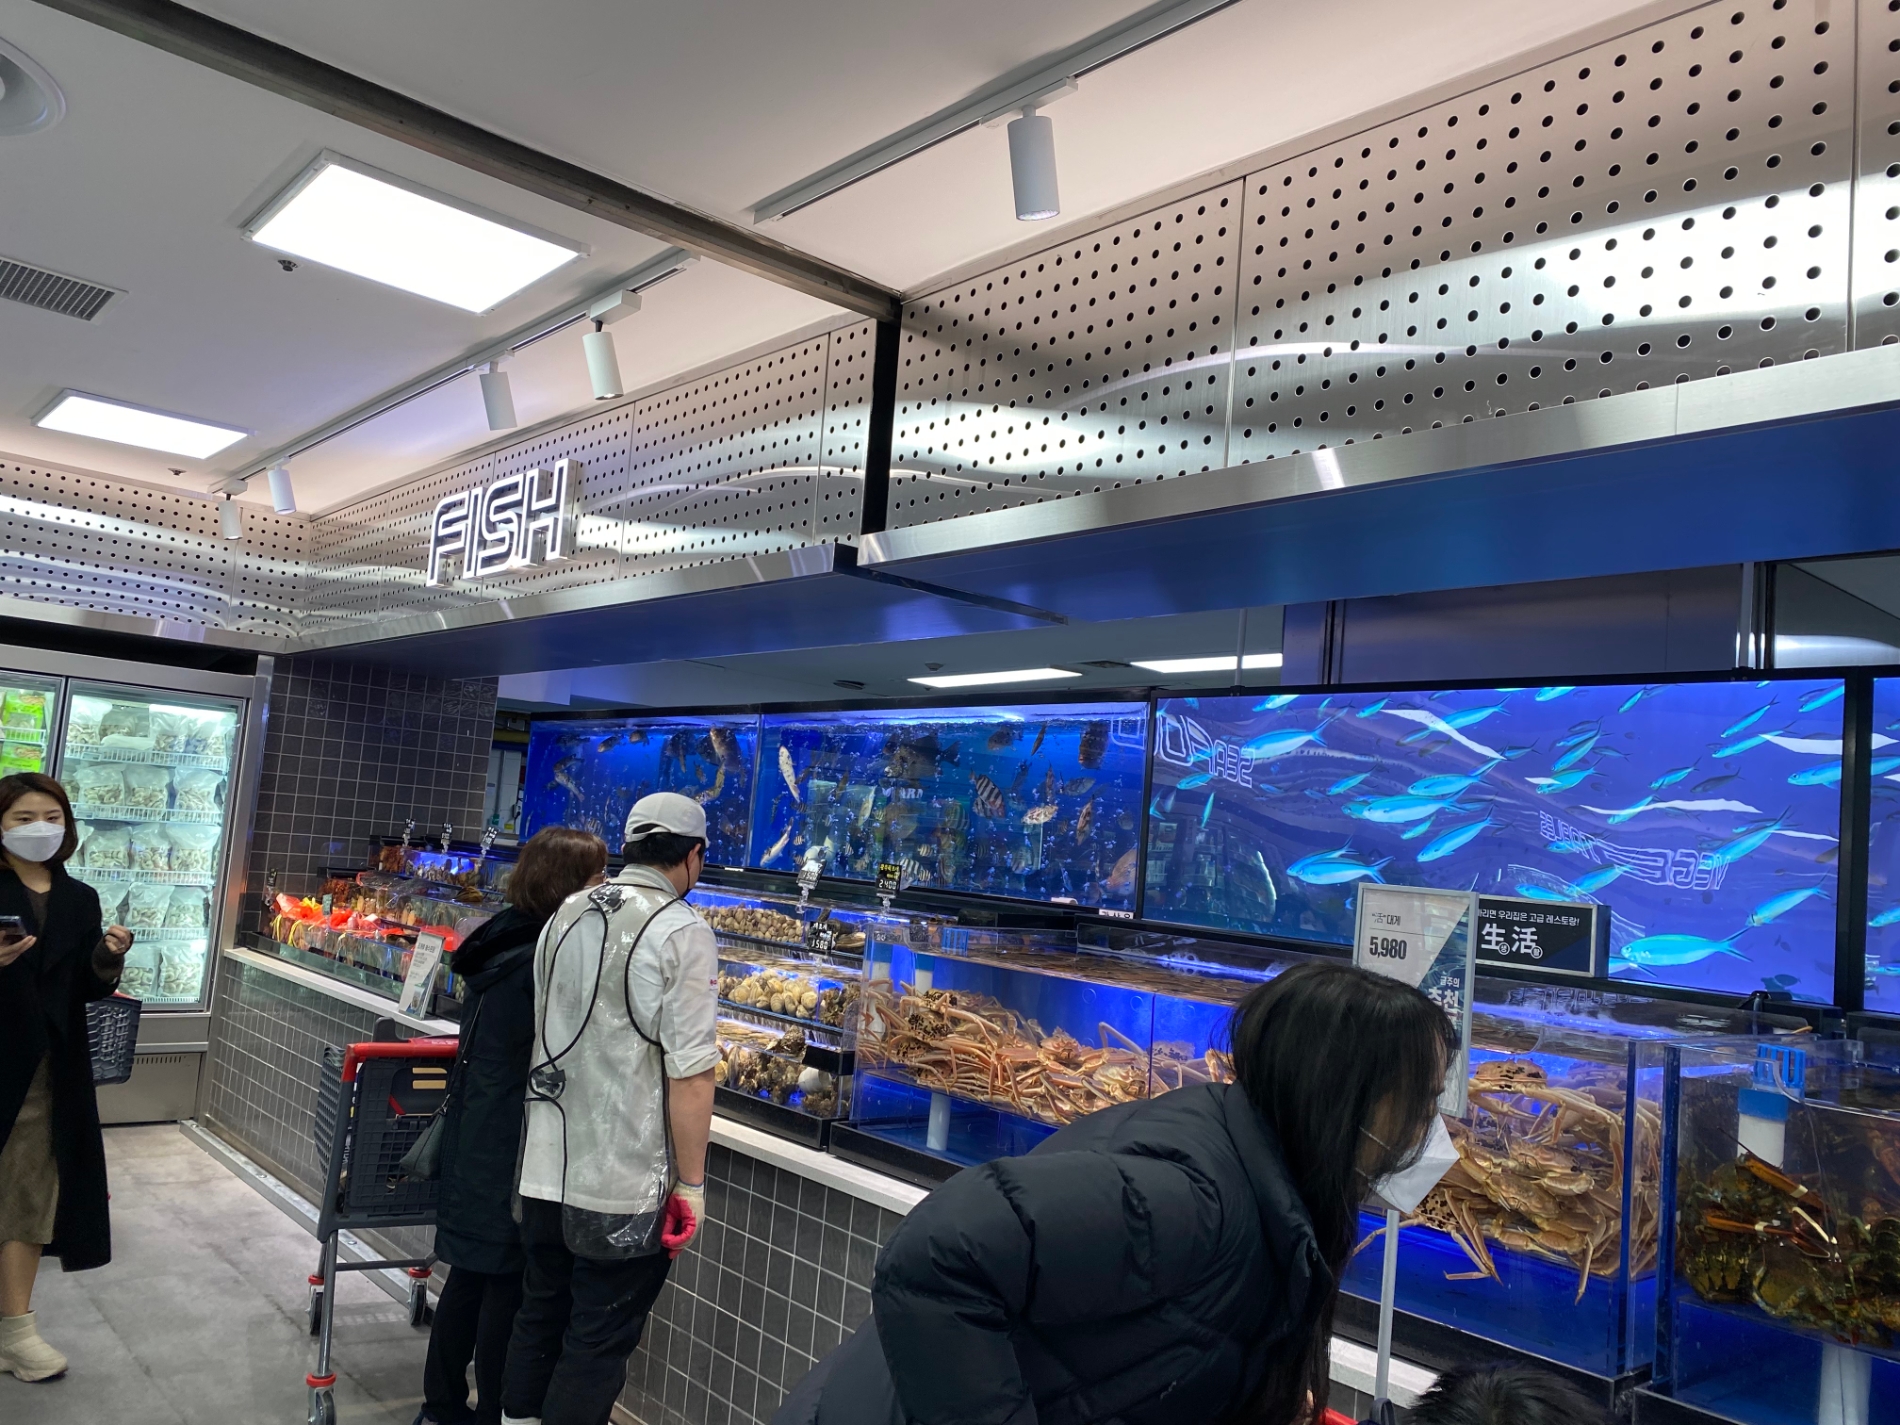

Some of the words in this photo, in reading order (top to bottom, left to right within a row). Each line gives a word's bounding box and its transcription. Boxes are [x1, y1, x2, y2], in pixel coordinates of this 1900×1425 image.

[426, 458, 570, 587] FISH
[1498, 910, 1528, 922] 우리집은
[1529, 913, 1544, 924] 고급
[1546, 914, 1580, 927] 레스토랑!
[1369, 936, 1408, 960] 5,980
